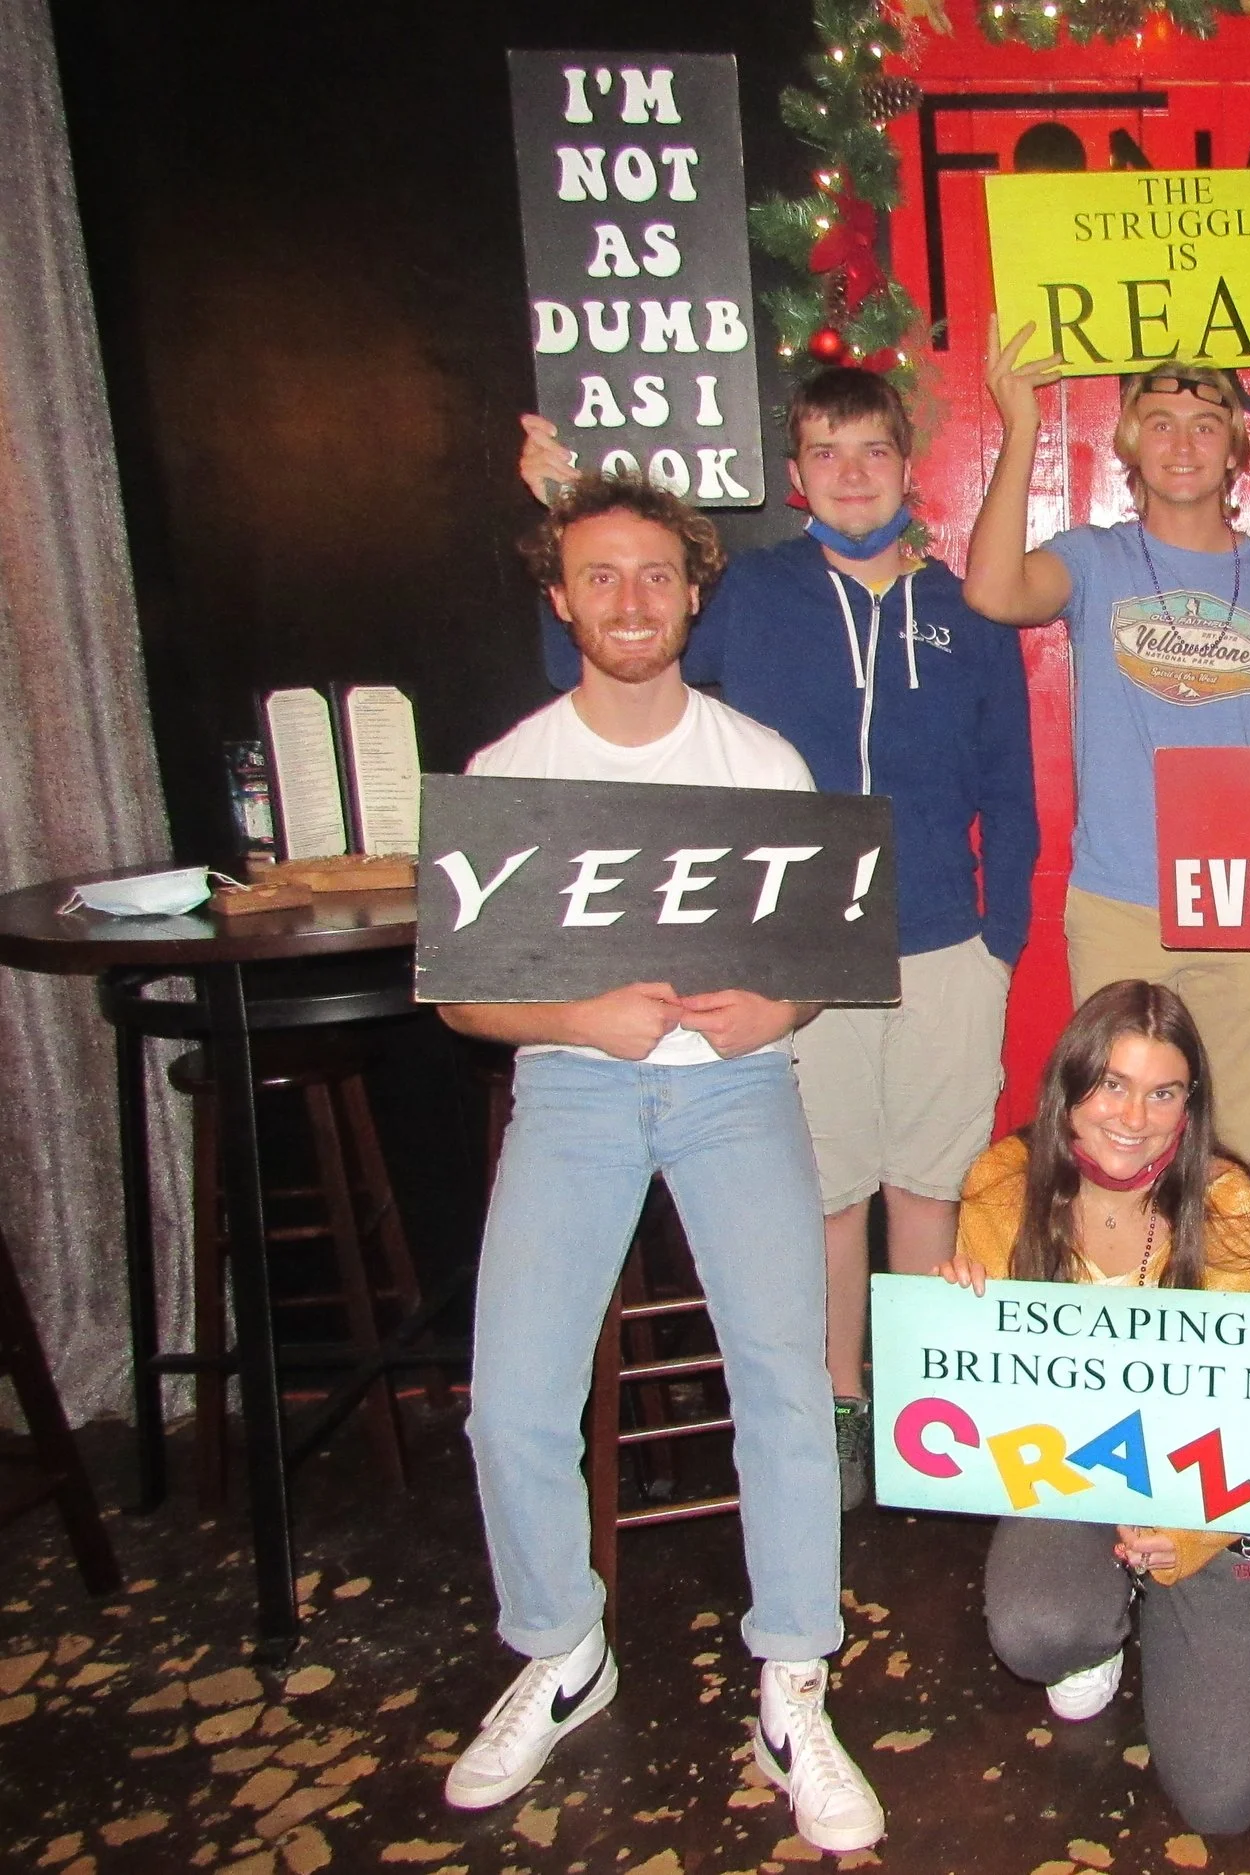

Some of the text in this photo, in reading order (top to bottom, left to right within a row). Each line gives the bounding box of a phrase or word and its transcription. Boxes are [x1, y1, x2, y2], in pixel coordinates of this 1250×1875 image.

[563, 68, 682, 124] I'M
[556, 146, 699, 202] NOT
[1138, 177, 1214, 205] THE
[588, 223, 682, 277] AS
[1166, 243, 1198, 272] IS
[534, 300, 749, 354] DUMB
[573, 375, 724, 428] AS I
[1137, 624, 1250, 664] Yellowstone
[1145, 651, 1216, 666] NATIONAL PARK
[997, 1299, 1247, 1346] ESCAPING
[922, 1347, 1106, 1390] BRINGS
[1122, 1360, 1226, 1397] OUT
